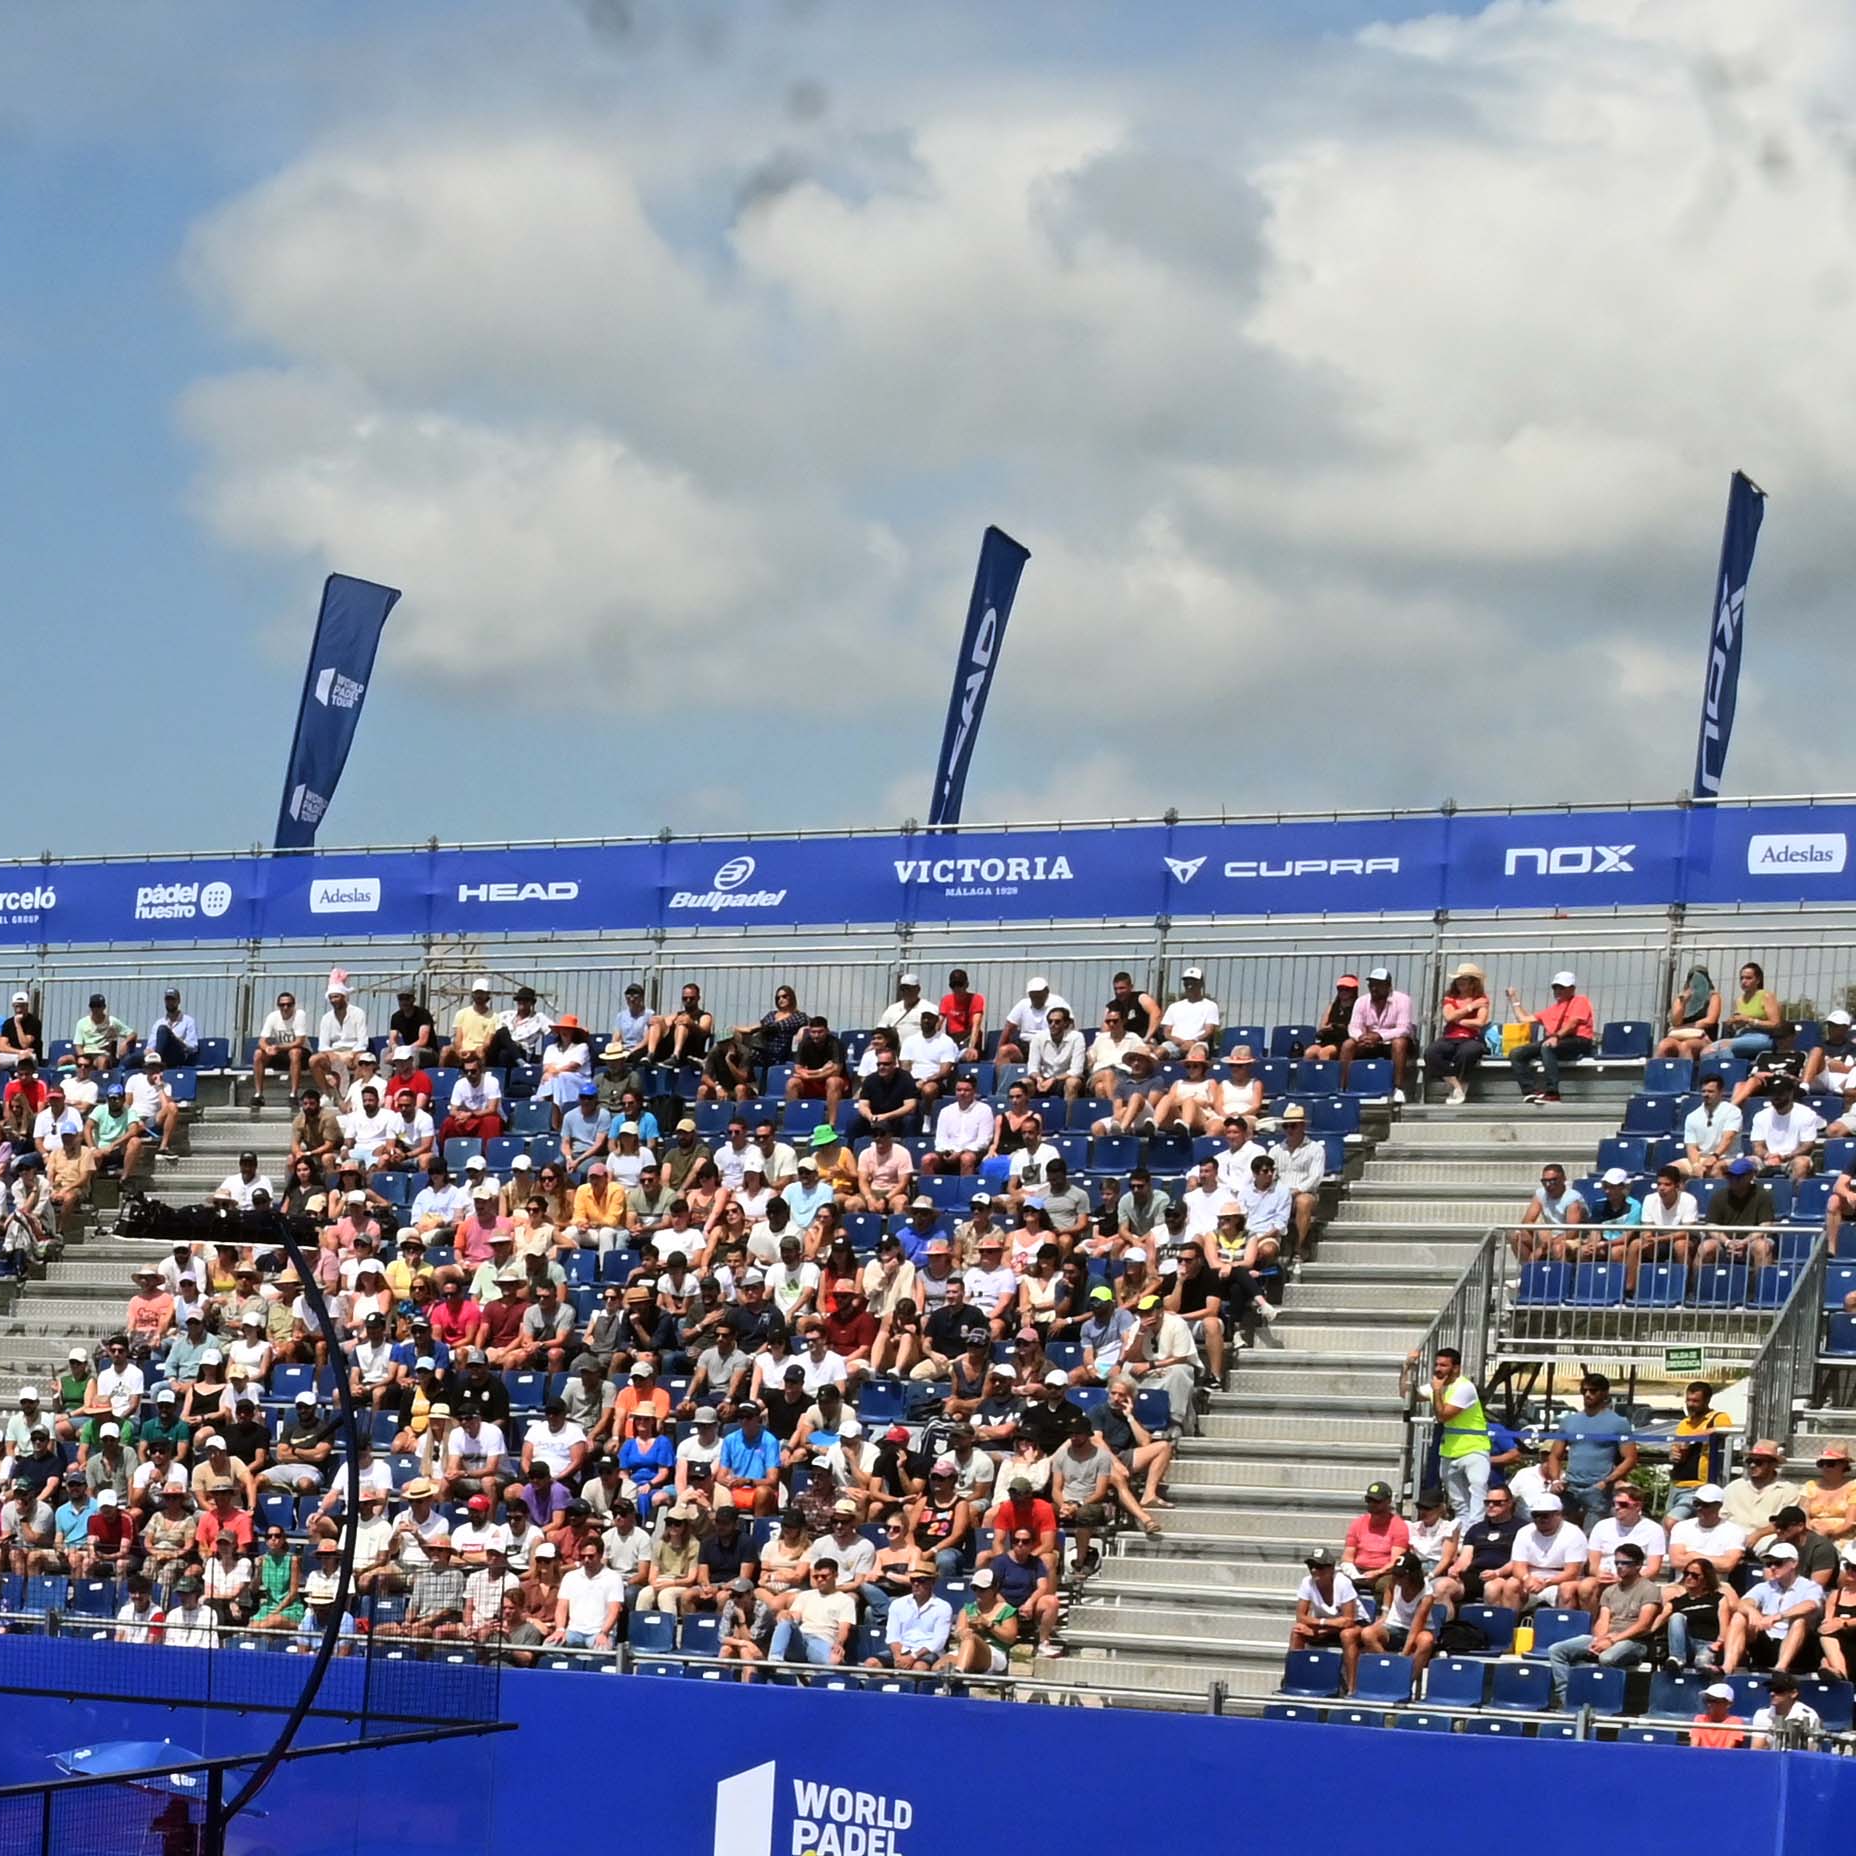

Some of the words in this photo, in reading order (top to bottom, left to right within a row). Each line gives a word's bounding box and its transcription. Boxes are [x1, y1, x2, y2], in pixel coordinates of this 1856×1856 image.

[1761, 844, 1833, 866] Adeslas
[894, 856, 1073, 883] VICTORIA
[1225, 858, 1399, 877] CUPRA
[136, 882, 198, 906] pádel
[319, 886, 372, 906] Adeslas
[459, 882, 578, 902] HEAD
[669, 890, 786, 911] Bullpadel
[135, 900, 196, 920] nuestro
[794, 1779, 912, 1831] WORLD
